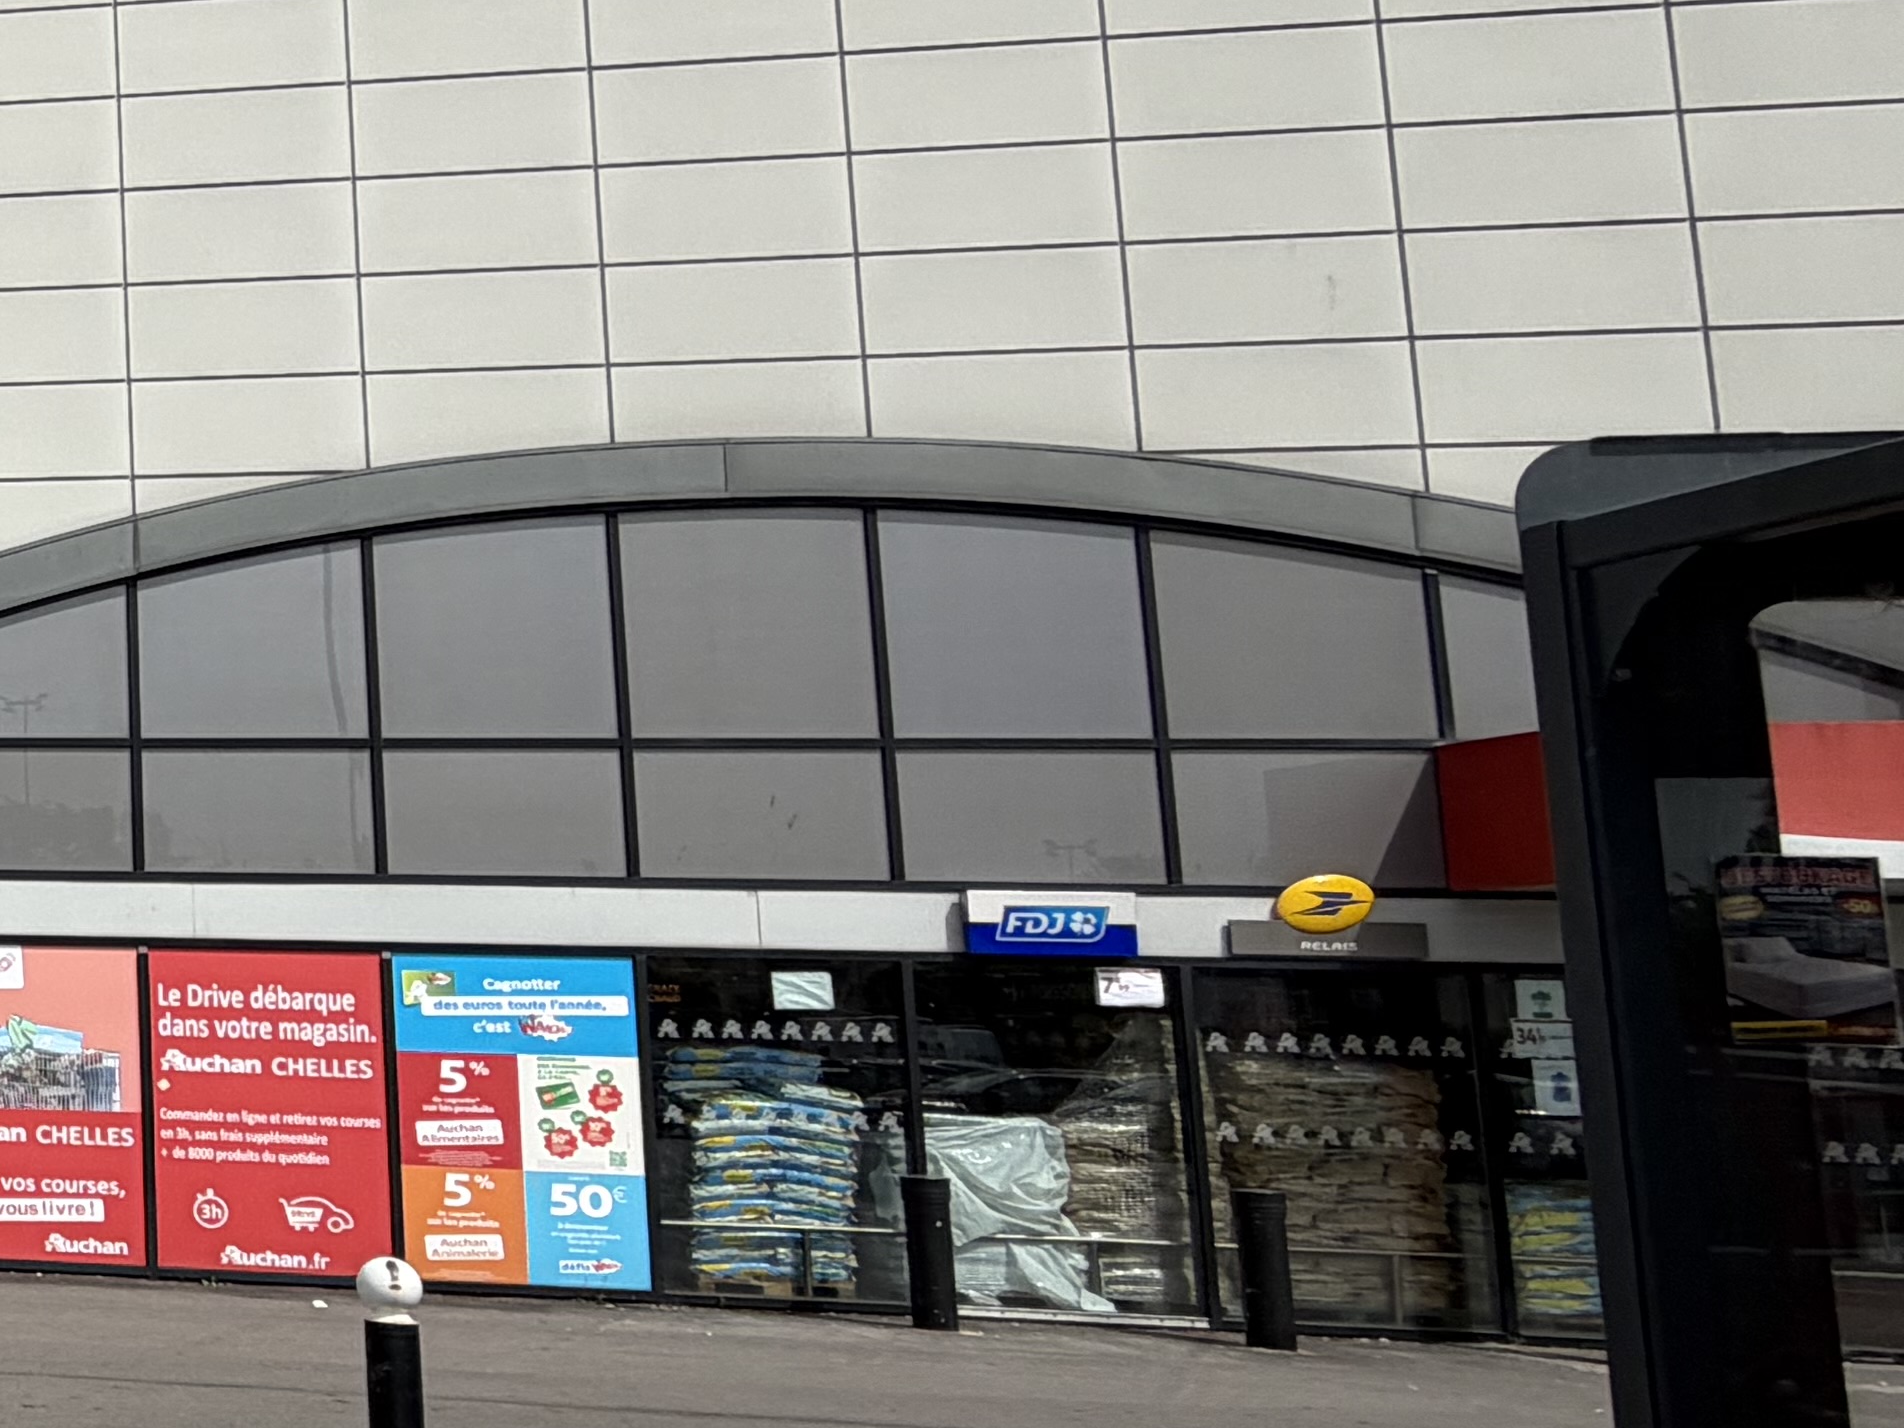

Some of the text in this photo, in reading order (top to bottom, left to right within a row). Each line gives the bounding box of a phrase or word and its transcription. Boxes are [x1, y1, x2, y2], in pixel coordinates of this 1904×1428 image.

[1005, 911, 1066, 935] FDJ
[1300, 940, 1358, 951] RELAIS
[482, 978, 561, 992] Cagnotter
[157, 983, 356, 1017] Le Drive débarque
[433, 999, 607, 1012] des euros toute l'année,
[158, 1012, 377, 1047] dans votre magasin.
[472, 1019, 512, 1034] c'est
[160, 1049, 374, 1079] Auchan CHELLES
[439, 1059, 490, 1094] 5%
[159, 1107, 382, 1129] Commandez en ligne et retirez vos courses
[437, 1123, 484, 1133] Auchan
[36, 1125, 135, 1147] CHELLES
[160, 1129, 174, 1139] en
[194, 1131, 218, 1141] sans
[220, 1129, 243, 1142] frais
[172, 1147, 186, 1159] de
[216, 1148, 260, 1163] produits
[262, 1151, 276, 1162] du
[278, 1152, 330, 1166] quotidien
[0, 1176, 36, 1192] vos
[41, 1178, 126, 1198] courses,
[443, 1172, 496, 1207] 5%
[42, 1200, 86, 1216] livre
[200, 1203, 222, 1220] 3h
[550, 1182, 628, 1219] 50€
[44, 1233, 129, 1255] Auchan
[431, 1248, 500, 1258] Animalerie
[440, 1238, 488, 1248] Auchan
[220, 1245, 331, 1270] Auchan.fr
